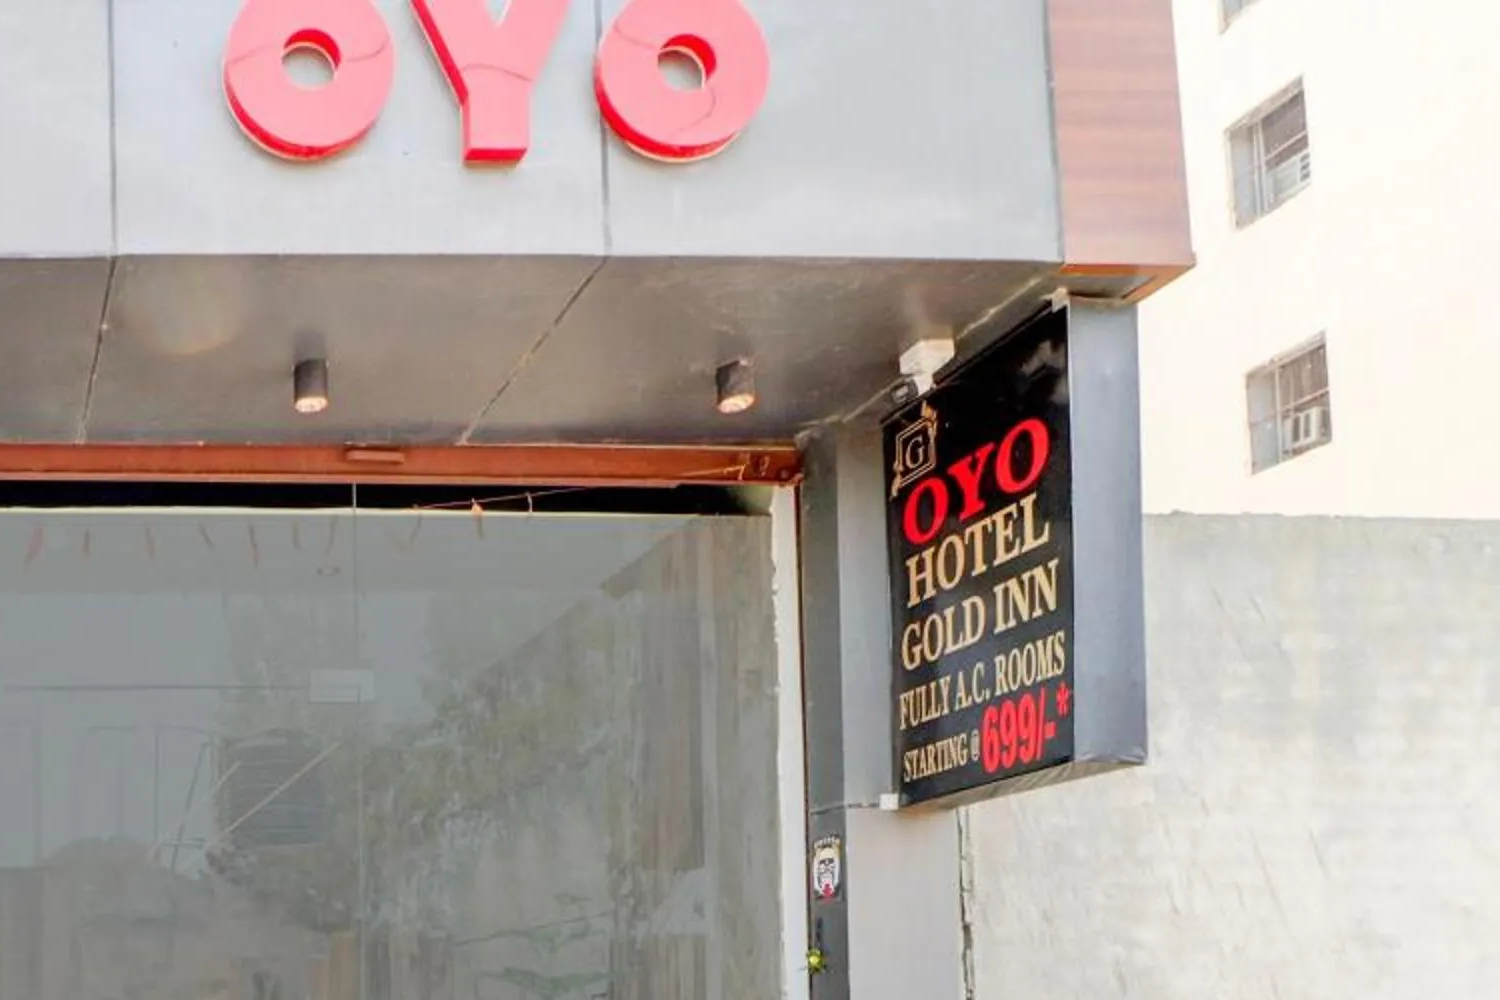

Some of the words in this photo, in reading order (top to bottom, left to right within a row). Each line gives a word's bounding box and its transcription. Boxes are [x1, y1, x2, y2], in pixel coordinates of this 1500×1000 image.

[222, 0, 771, 163] OYO
[903, 418, 1050, 545] OYO
[905, 491, 1050, 608] HOTEL
[901, 596, 986, 671] GOLD
[993, 558, 1059, 635] INN
[899, 674, 951, 730] FULLY
[954, 661, 991, 711] A.C.
[994, 630, 1065, 697] ROOMS
[903, 731, 969, 783] STARTING
